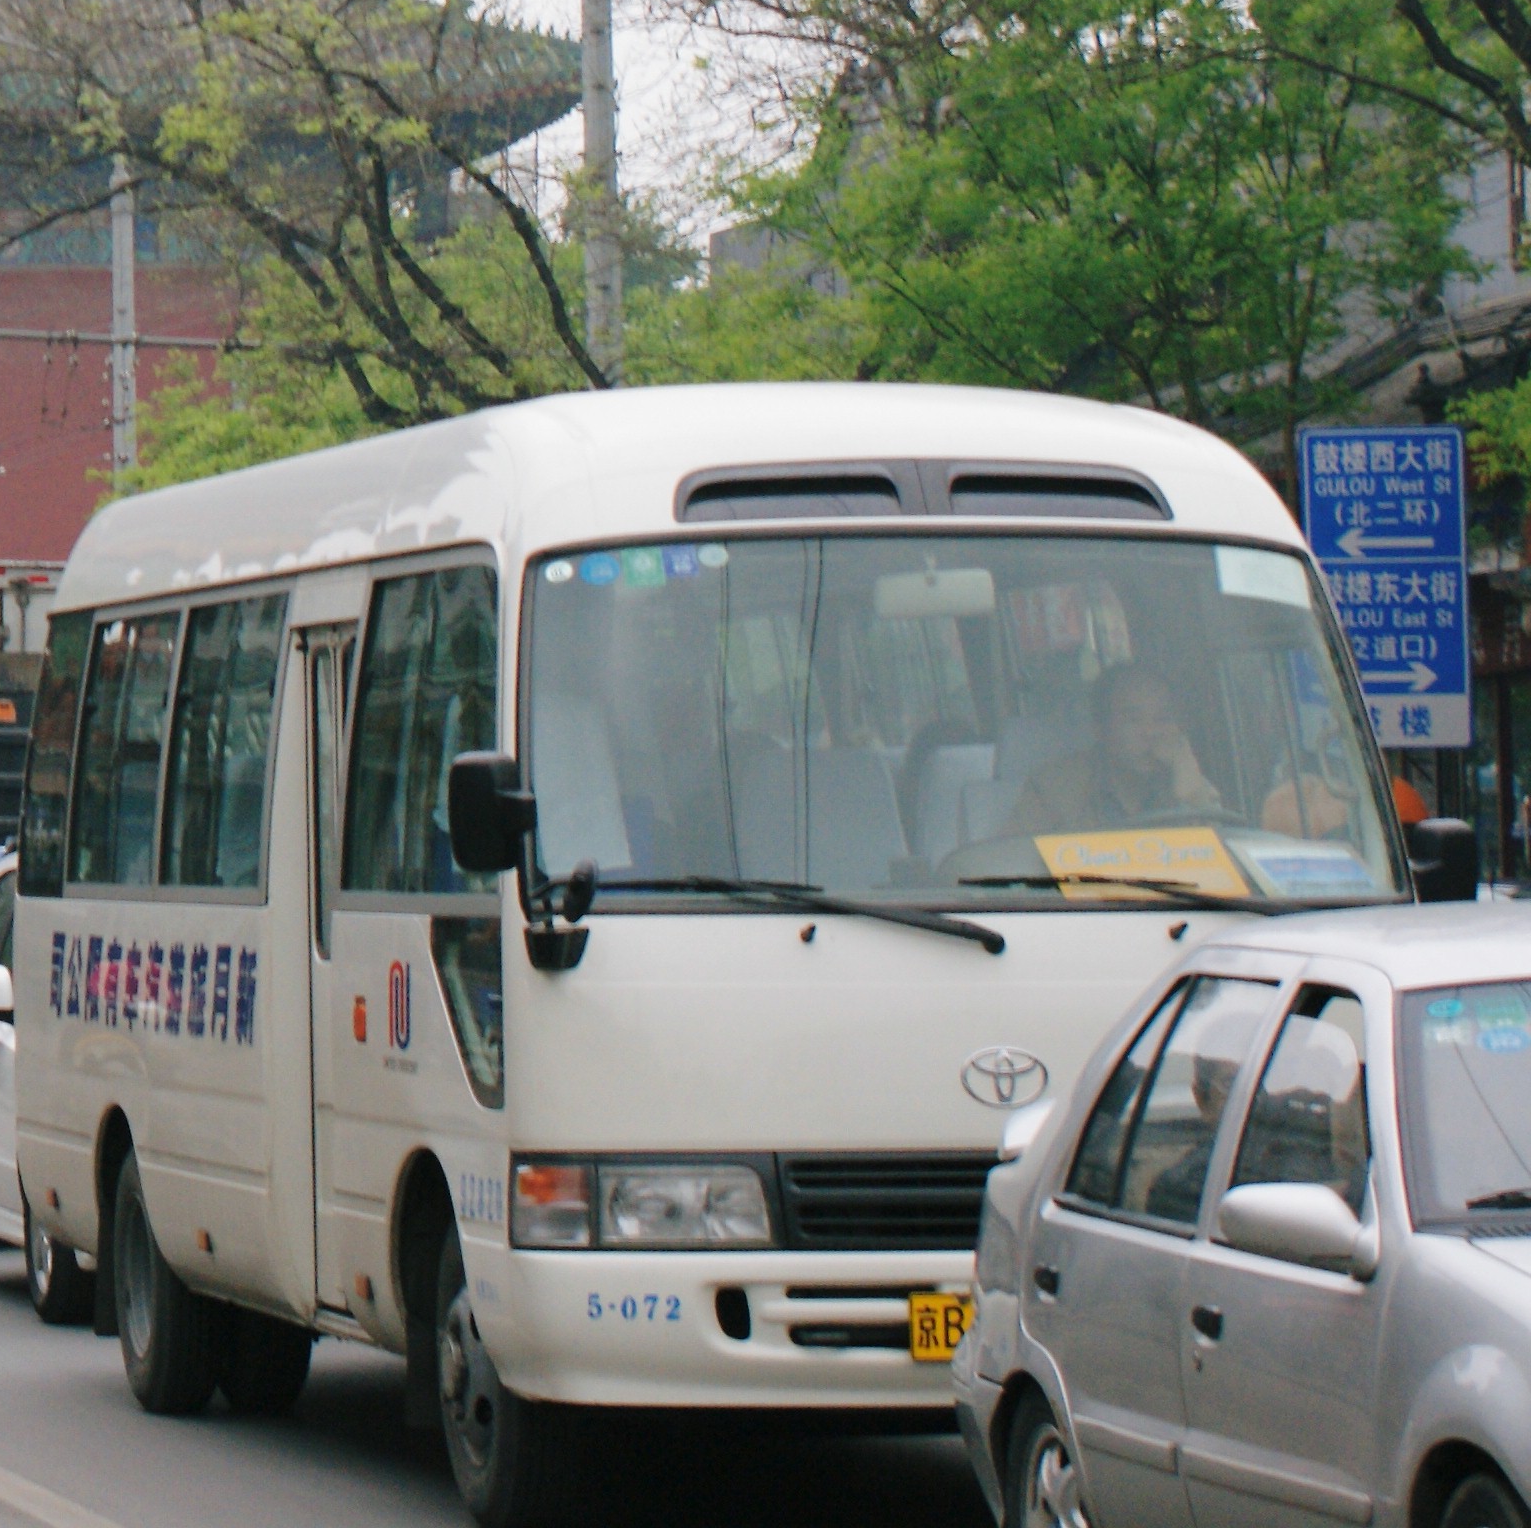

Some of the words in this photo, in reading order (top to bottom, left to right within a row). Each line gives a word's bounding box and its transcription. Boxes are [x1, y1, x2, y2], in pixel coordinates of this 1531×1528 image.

[1312, 439, 1452, 473] 鼓楼西大街
[1314, 475, 1376, 497] GULOU
[1384, 475, 1426, 496] West
[1433, 475, 1452, 495] St
[1392, 607, 1427, 629] East
[1435, 608, 1454, 629] St
